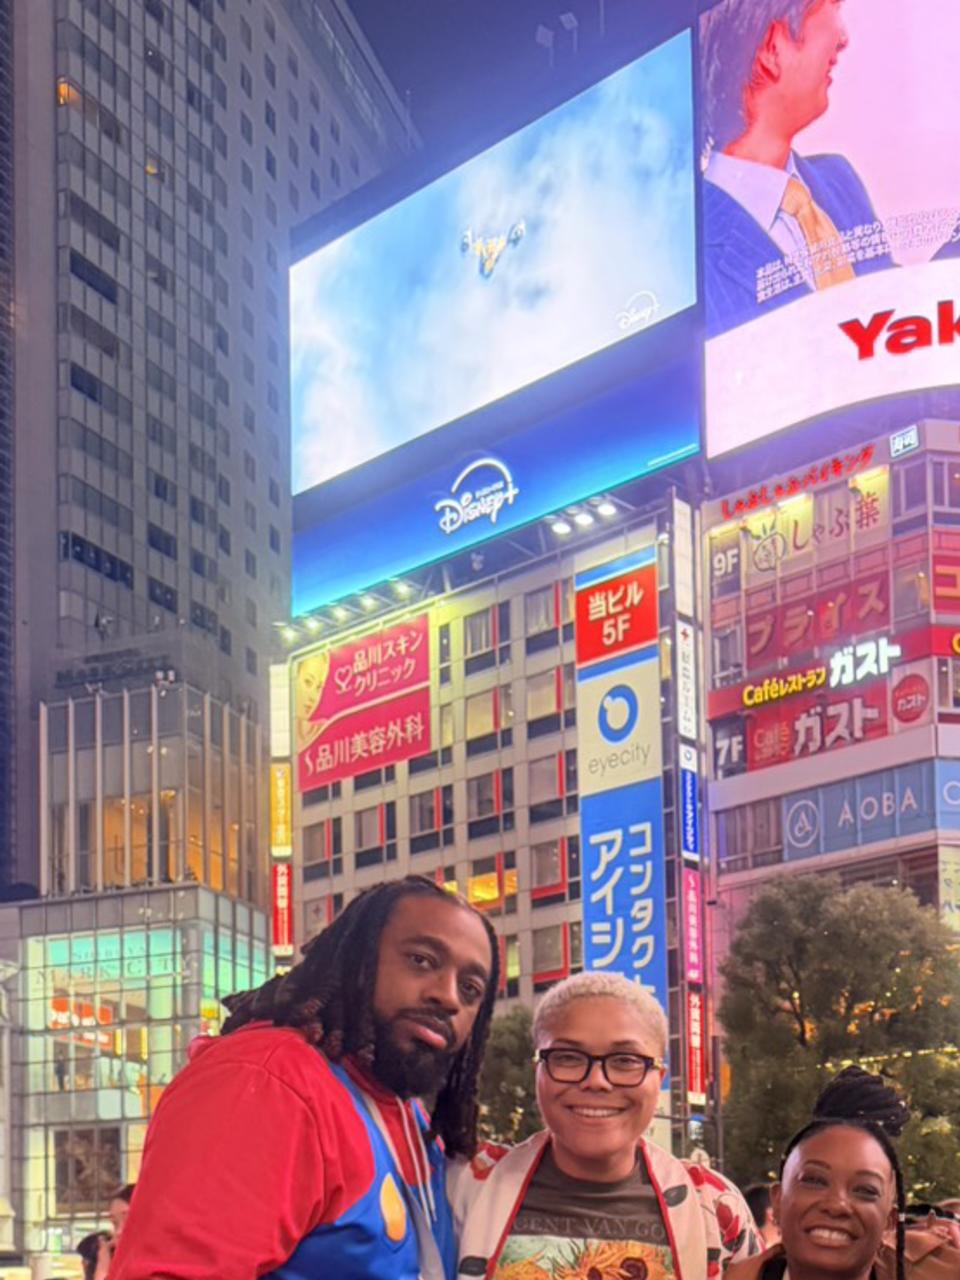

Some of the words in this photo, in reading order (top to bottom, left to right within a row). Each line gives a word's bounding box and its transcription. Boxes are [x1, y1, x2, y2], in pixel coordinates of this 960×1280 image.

[720, 443, 876, 521] しゃぶしゃぶバイキング
[434, 478, 520, 535] Disney+
[792, 491, 881, 551] しゃぶ葉
[713, 549, 739, 577] 9F
[588, 581, 645, 622] 当ビル
[353, 629, 424, 674] 品川スキン
[602, 613, 632, 647] 5F
[355, 657, 417, 698] クリニック
[829, 634, 902, 689] ガスト
[316, 712, 425, 774] 品川美容外科
[794, 697, 880, 756] ガスト
[587, 741, 652, 778] eyecity
[716, 735, 744, 766] 7F
[837, 785, 918, 828] AOBA
[589, 828, 625, 976] アイシ
[513, 1215, 577, 1234] CENT
[584, 1216, 627, 1236] VAN
[635, 1219, 667, 1239] GO
